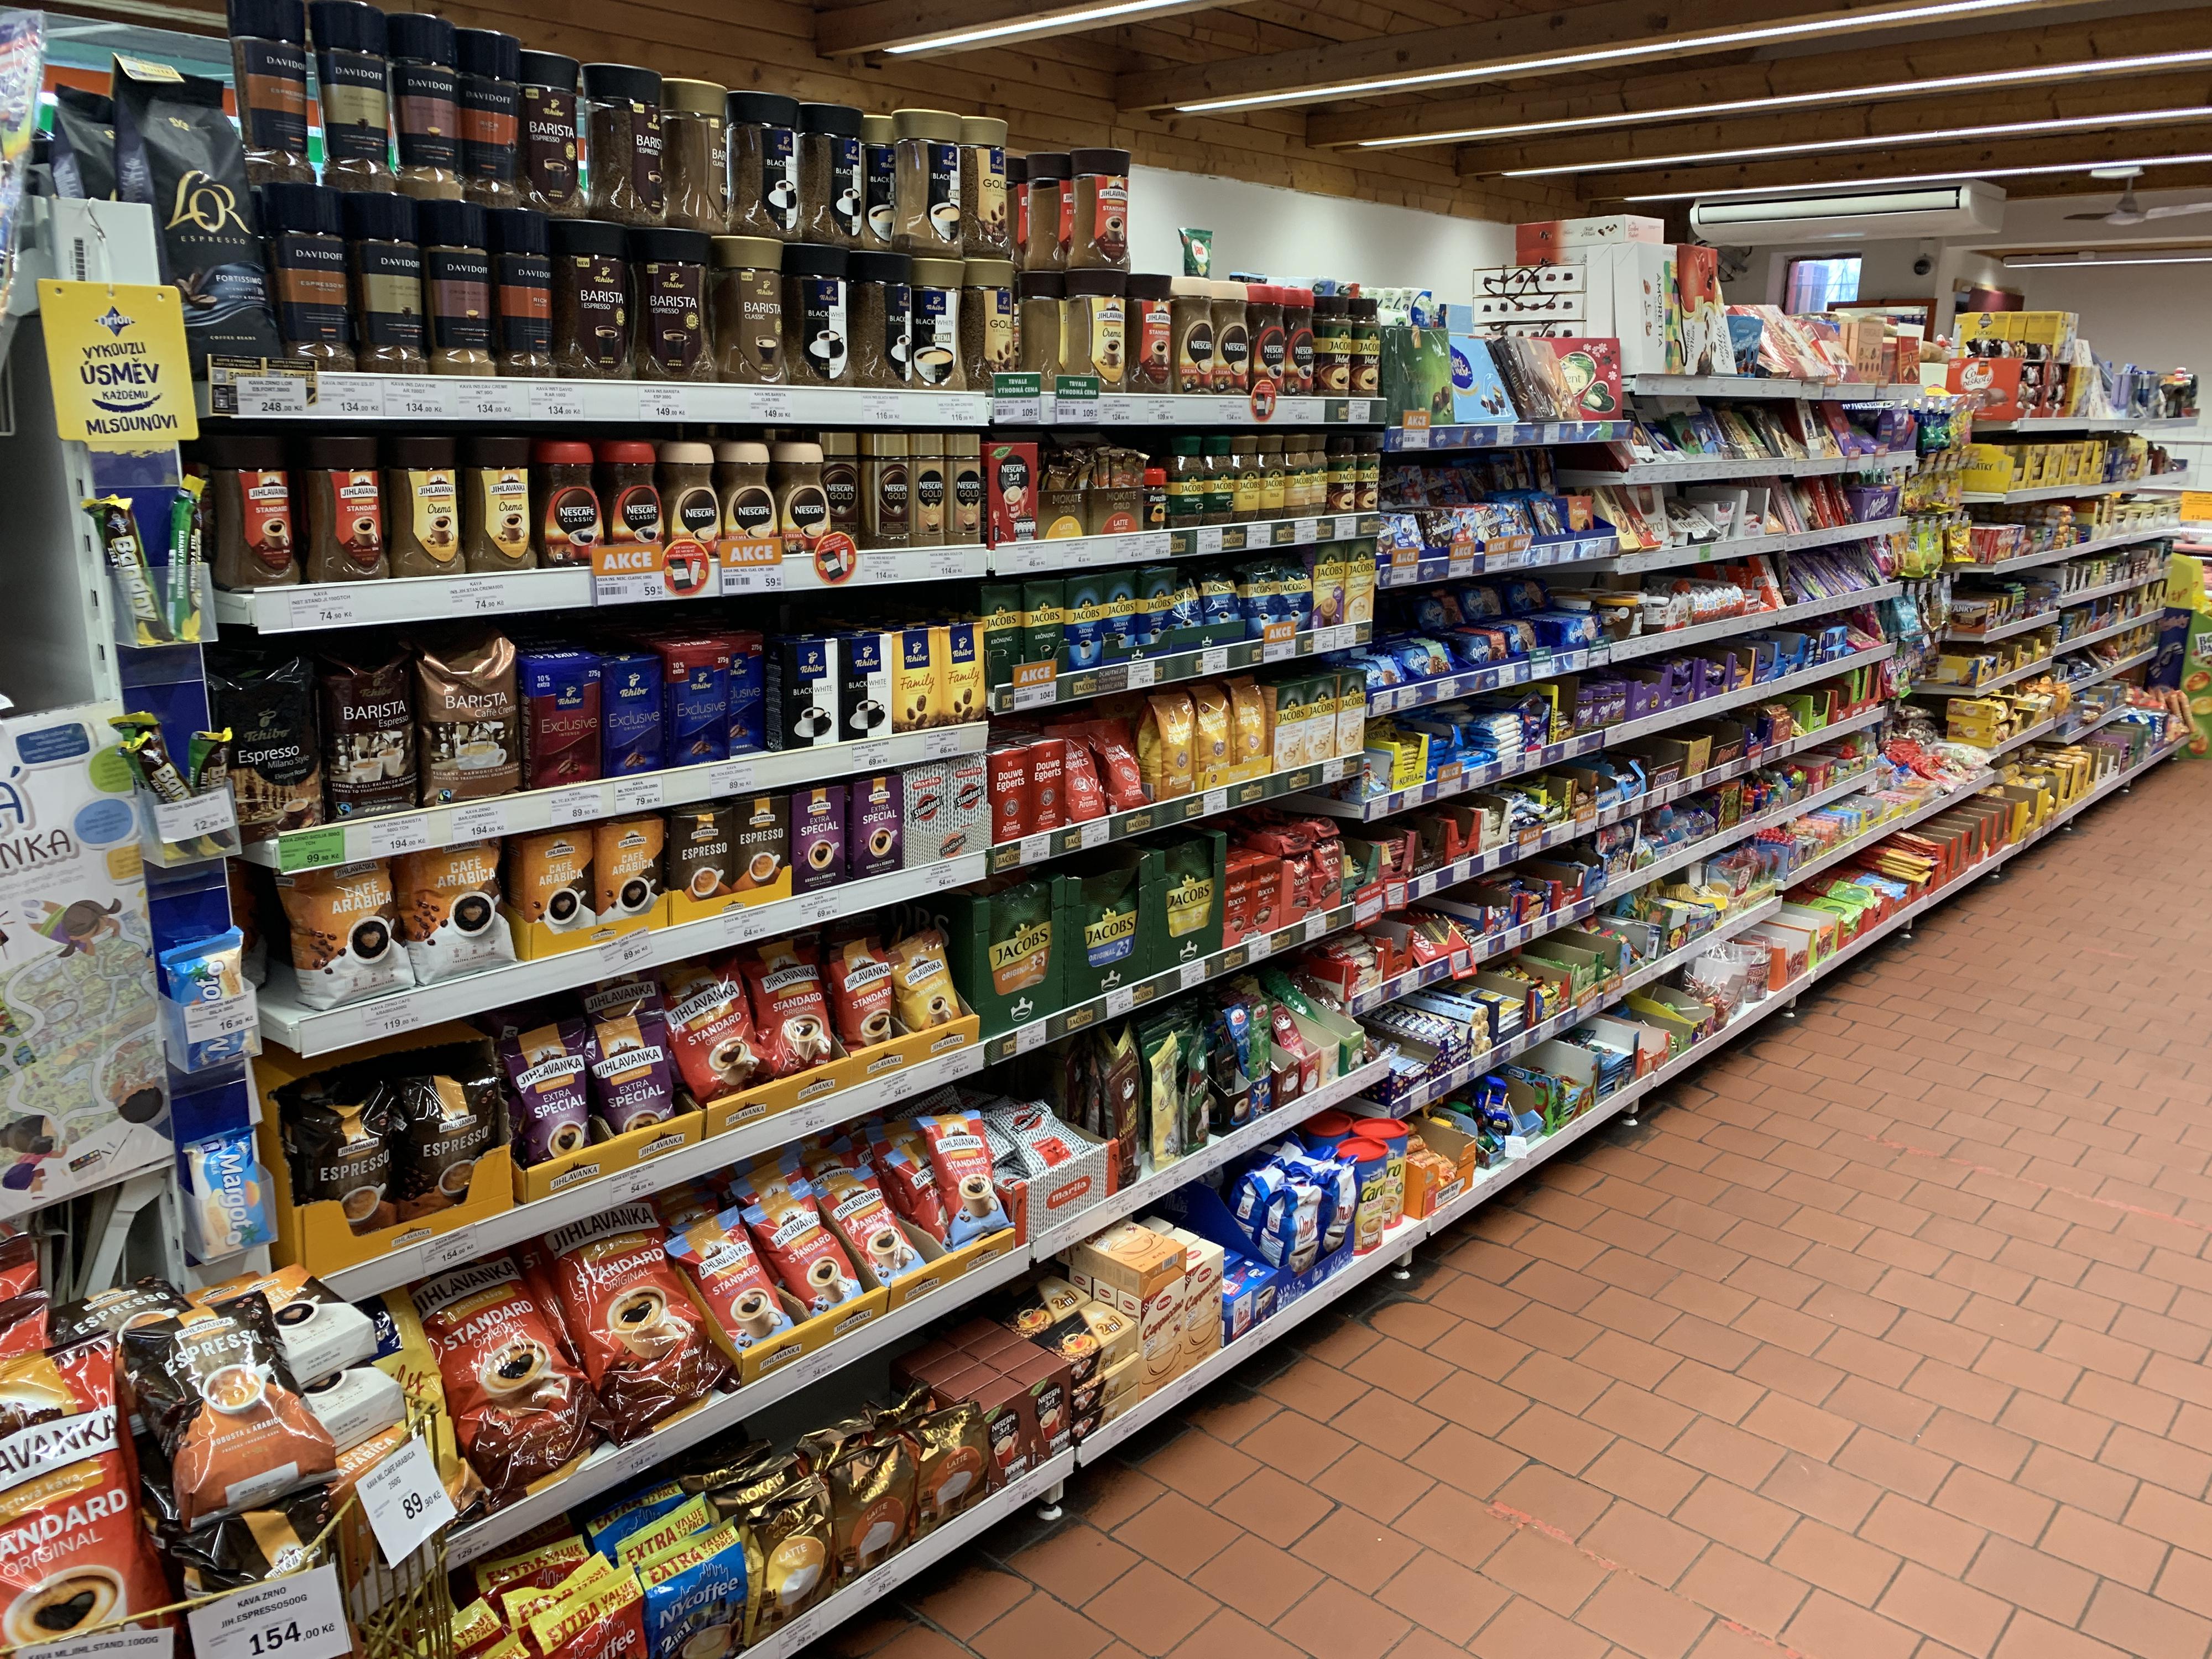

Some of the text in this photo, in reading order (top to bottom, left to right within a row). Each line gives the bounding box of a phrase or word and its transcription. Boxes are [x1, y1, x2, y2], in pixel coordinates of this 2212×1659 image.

[335, 67, 383, 81] DAVIDOFF
[529, 121, 575, 139] BARISTA
[766, 159, 785, 167] BLACK
[296, 249, 343, 261] DAVIDOFF
[447, 264, 487, 274] DAVIDOFF
[216, 274, 262, 285] FORTISSIMO
[650, 295, 697, 308] BARISTA
[744, 302, 781, 314] BARISTA
[98, 315, 132, 327] Orion
[82, 342, 145, 359] VYKOUZLI
[80, 357, 159, 385] ÚSMĚV
[102, 390, 148, 400] KAŽDÉMU
[998, 386, 1024, 394] VÝHODNÁ
[86, 414, 178, 435] MLSOUNOVI
[342, 487, 377, 496] JIHLAVANKA
[419, 486, 453, 495] JIHLAVANKA
[491, 484, 525, 493] JIHLAVANKA
[1052, 494, 1081, 504] MOKATE
[427, 504, 451, 514] Crema
[499, 502, 523, 512] Crema
[1869, 496, 1888, 519] Milka
[1678, 518, 1707, 531] merci
[730, 545, 773, 562] AKCE
[1396, 551, 1415, 564] AKCE
[1348, 562, 1374, 575] JACOBS
[765, 578, 775, 587] 59
[645, 586, 656, 596] 59
[1072, 609, 1100, 622] JACOBS
[1269, 625, 1292, 639] AKCE
[1569, 628, 1583, 640] Orion
[991, 637, 1012, 645] KRÖNUNG
[905, 655, 927, 663] Tchibo
[953, 649, 974, 658] Tchibo
[855, 658, 879, 667] Tchibo
[900, 673, 935, 695] Family
[793, 687, 812, 696] BLACK
[475, 705, 516, 718] Caffè Crema
[677, 701, 726, 717] Exclusive
[378, 714, 408, 728] Espresso
[609, 711, 660, 727] Exclusive
[1198, 711, 1223, 723] Douwe
[541, 717, 597, 733] Exclusive
[1167, 732, 1192, 743] Egberts
[238, 744, 299, 765] Espresso
[268, 754, 309, 769] Milano Style
[1036, 759, 1060, 770] Douwe
[1035, 769, 1061, 781] Egberts
[1169, 775, 1191, 786] Paloma
[1399, 772, 1419, 786] KOFILA
[914, 777, 939, 788] marila
[913, 796, 941, 818] Standard
[1038, 813, 1056, 822] Aroma
[1002, 823, 1020, 833] Aroma
[621, 851, 644, 863] CAFÉ
[682, 842, 727, 860] ESPRESSO
[450, 855, 481, 874] CAFÉ
[539, 869, 583, 886] ARABICA
[1257, 886, 1275, 898] ROCCA
[332, 891, 392, 915] ARABICA
[1228, 896, 1246, 907] ROCCA
[1087, 917, 1134, 946] JACOBS
[996, 928, 1048, 965] JACOBS
[766, 968, 816, 989] JIHLAVANKA
[225, 994, 248, 1003] MARGOT
[783, 1005, 816, 1016] ORIGINAL
[619, 1079, 649, 1094] EXTRA
[542, 1088, 571, 1103] EXTRA
[608, 1084, 665, 1108] SPECIAL
[534, 1095, 585, 1118] SPECIAL
[320, 1149, 389, 1182] ESPRESSO
[946, 1157, 987, 1170] STANDARD
[1051, 1180, 1087, 1201] marila
[602, 1267, 654, 1293] ORIGINAL
[1185, 1274, 1223, 1311] Cappuccino
[455, 1289, 503, 1314] poctivá káva
[1052, 1291, 1078, 1311] 2in1
[73, 1292, 170, 1335] ESPRESSO
[1142, 1299, 1184, 1340] Cappuccino
[212, 1428, 244, 1447] ROBUSTA
[252, 1417, 283, 1432] ARABICA
[946, 1453, 968, 1469] LATTE
[848, 1457, 897, 1495] MOKATE
[388, 1478, 401, 1490] 250G
[434, 1490, 441, 1500] Kč
[865, 1502, 888, 1522] LATTE
[679, 1517, 705, 1537] 12 PACK
[2, 1528, 103, 1577] ORIGINAL
[778, 1543, 807, 1562] LATTE
[237, 1586, 286, 1608] KAVA ZRNO
[599, 1579, 634, 1604] VALUE
[221, 1594, 307, 1629] JIH.ESPRESSO500G
[321, 1623, 335, 1633] Kč
[458, 1612, 492, 1640] VALUE
[545, 1603, 600, 1646] EXTRA
[661, 1620, 694, 1654] 2in1
